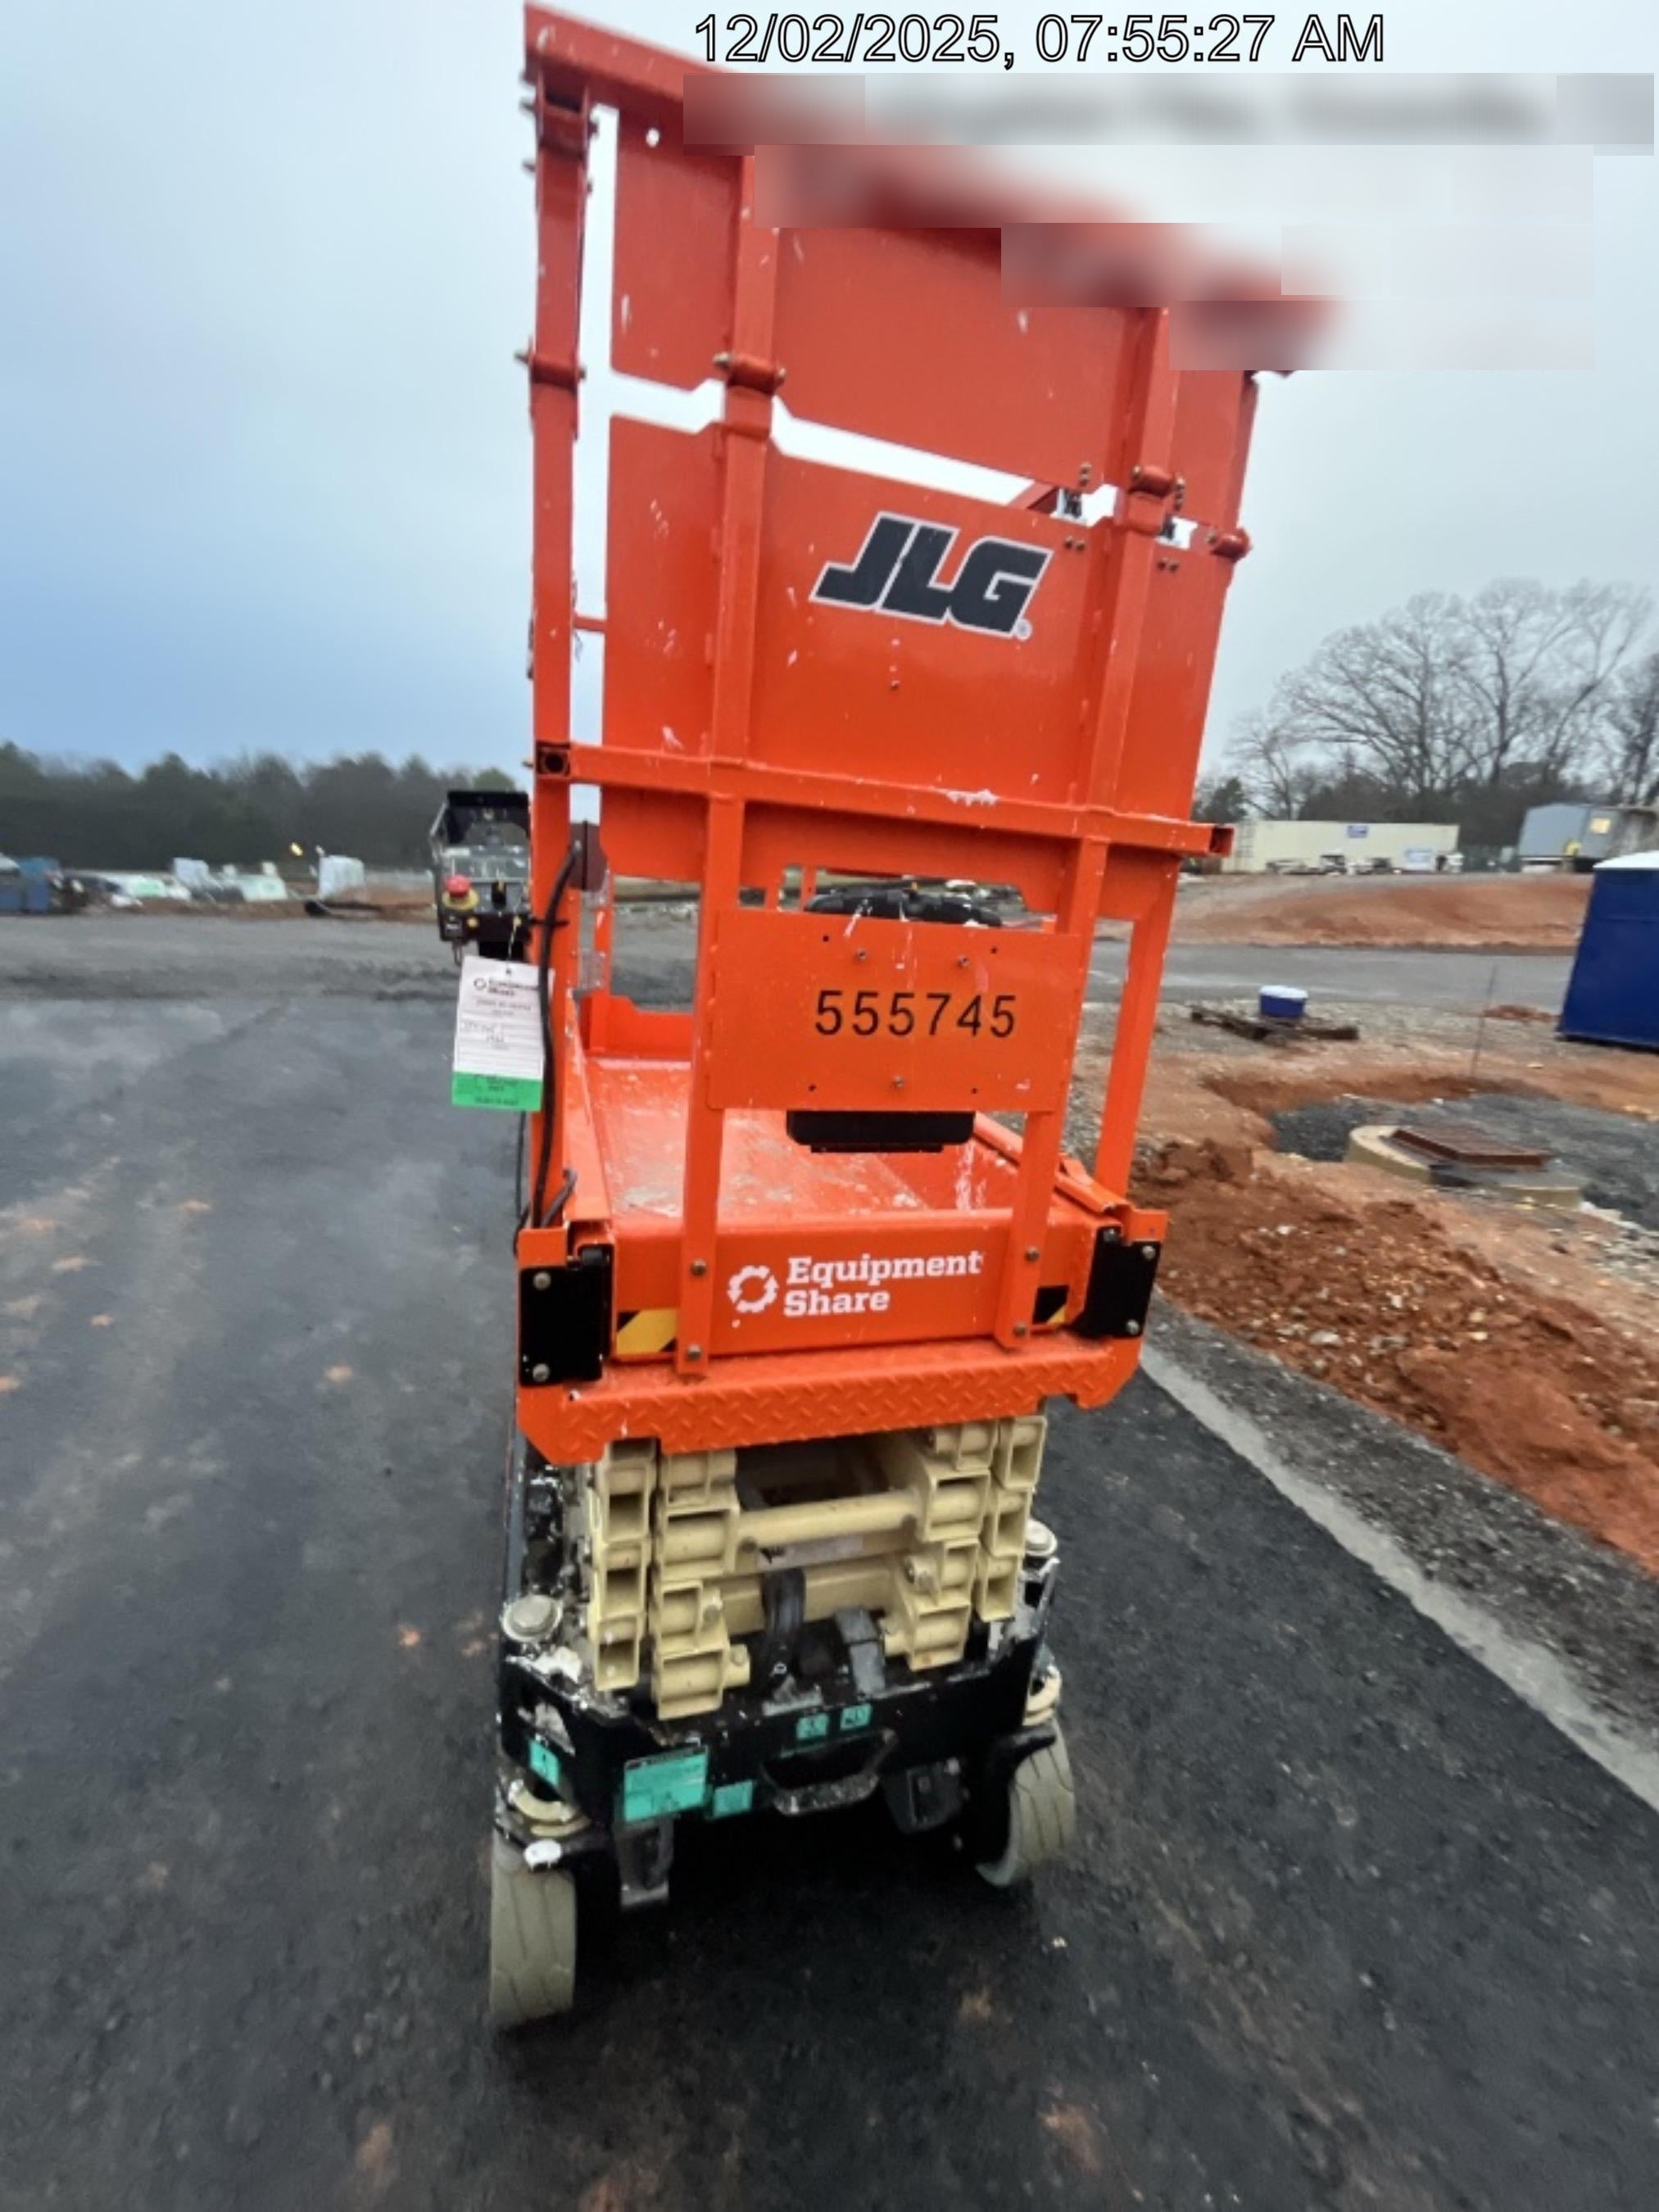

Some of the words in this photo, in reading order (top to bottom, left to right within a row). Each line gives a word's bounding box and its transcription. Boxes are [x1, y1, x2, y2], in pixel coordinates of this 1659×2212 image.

[809, 512, 1054, 638] JLG
[815, 990, 1016, 1038] 555745
[786, 1250, 983, 1289] Equipment
[783, 1289, 890, 1317] Share
